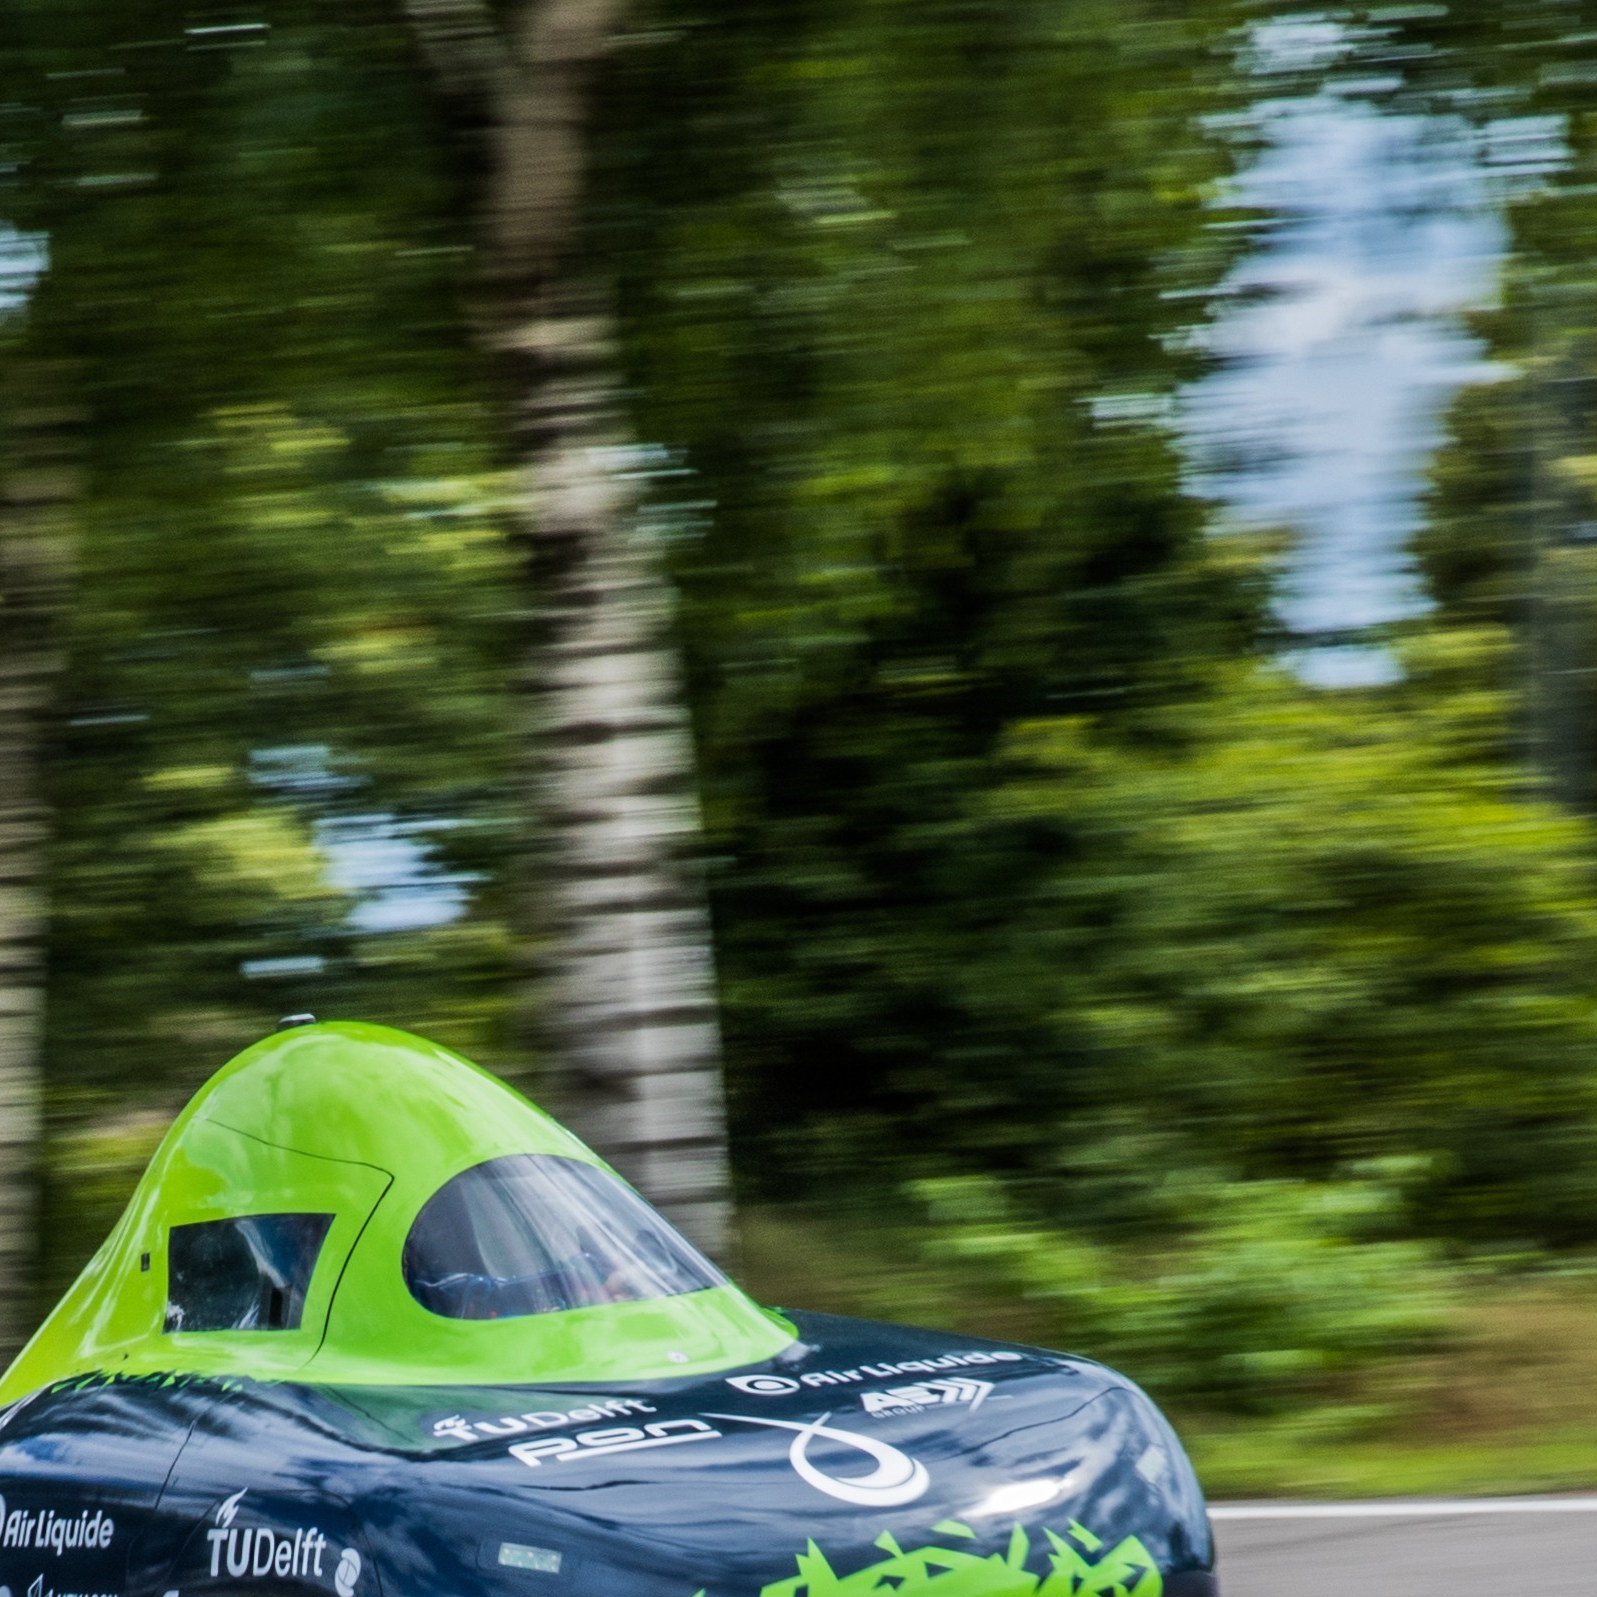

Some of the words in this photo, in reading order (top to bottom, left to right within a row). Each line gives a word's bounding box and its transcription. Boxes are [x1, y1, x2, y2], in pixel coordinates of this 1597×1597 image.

[800, 1369, 863, 1388] Air
[859, 1351, 1023, 1378] Liquide
[521, 1400, 657, 1428] Delft
[3, 1510, 36, 1547] Air
[35, 1510, 115, 1556] Liquide
[207, 1528, 252, 1577] TU
[253, 1527, 327, 1577] Delft
